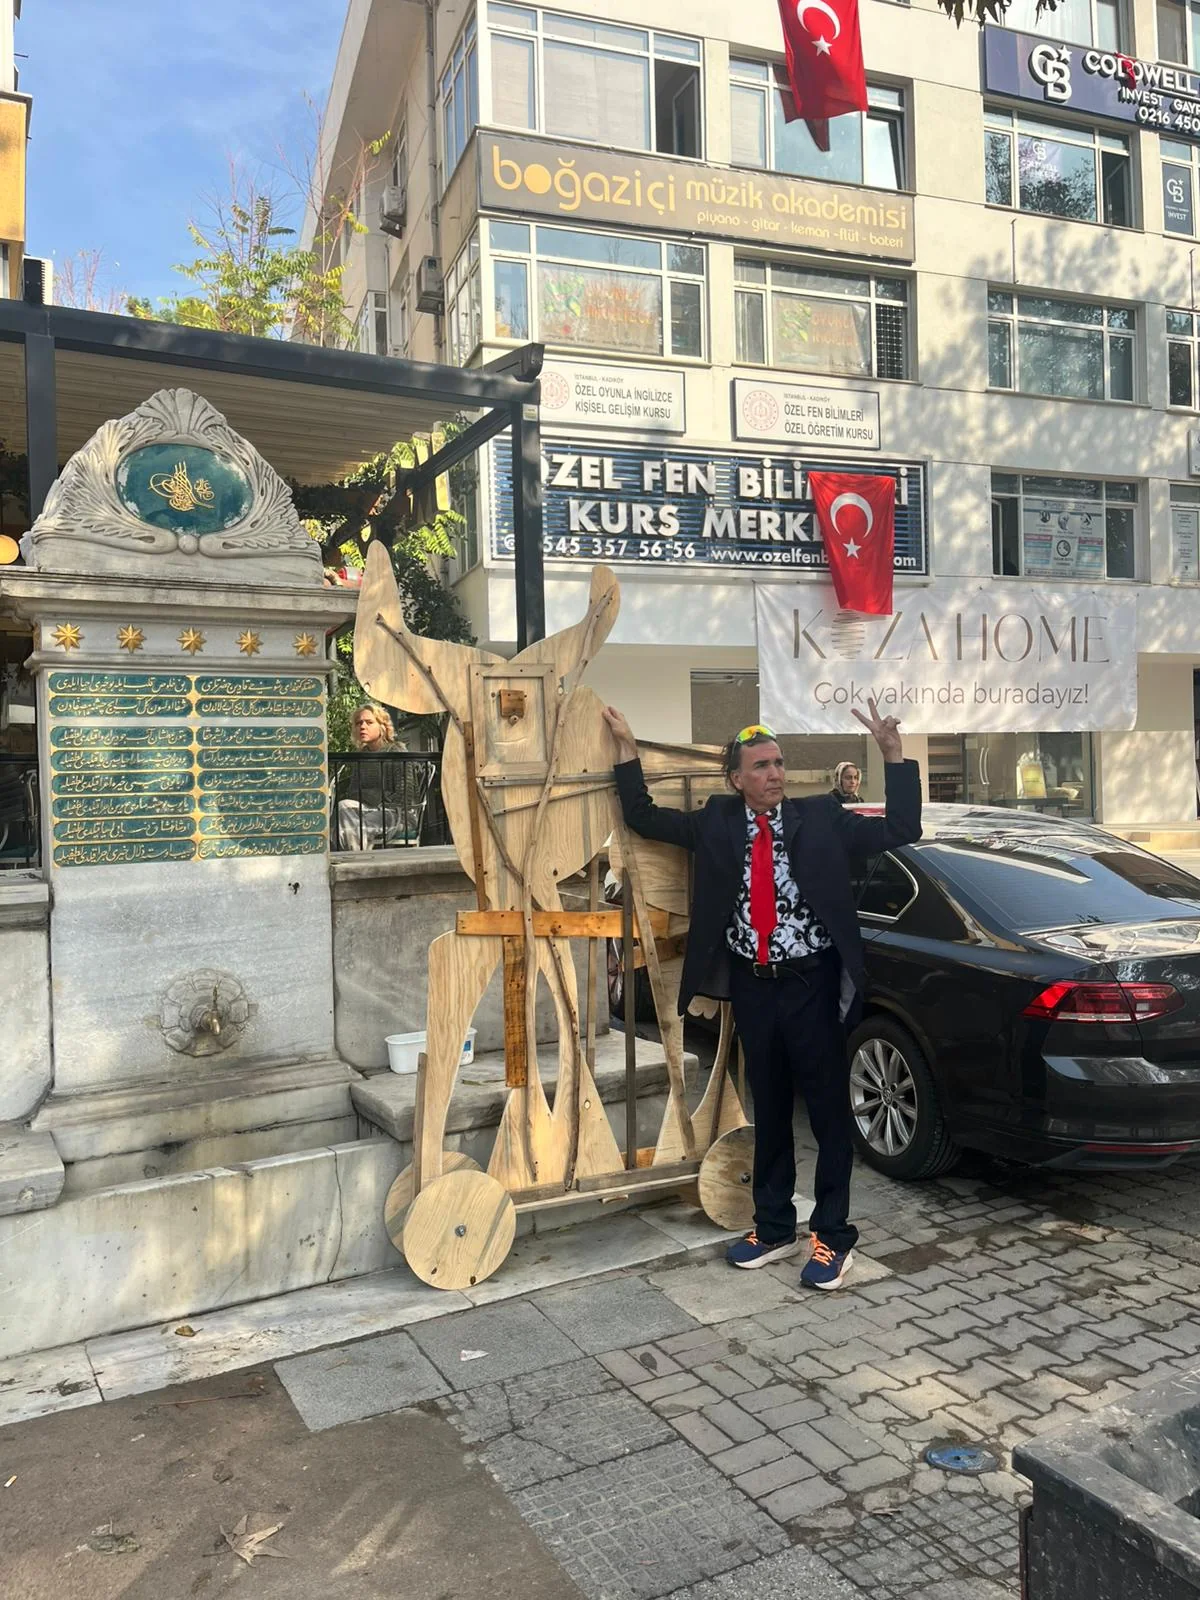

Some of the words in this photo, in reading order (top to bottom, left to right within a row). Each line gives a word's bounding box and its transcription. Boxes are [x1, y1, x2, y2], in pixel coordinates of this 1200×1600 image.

[1122, 87, 1165, 107] INVEST
[1139, 106, 1171, 125] 0216
[492, 144, 676, 216] boğaziçi
[686, 177, 763, 209] müzik
[772, 188, 907, 230] akademisi
[791, 221, 830, 239] keman
[870, 232, 904, 249] bateri
[574, 383, 599, 398] ÖZEL
[600, 386, 633, 400] OYUNLA
[634, 387, 673, 403] İNGİLİZCE
[575, 400, 607, 416] KİŞİSEL
[608, 403, 642, 418] GELİŞİM
[643, 407, 671, 419] KURSU
[784, 401, 806, 417] ÖZEL
[807, 406, 824, 418] FEN
[825, 407, 864, 422] BİLİMLERİ
[784, 419, 806, 435] ÖZEL
[807, 420, 845, 438] ÖĞRETİM
[846, 428, 874, 441] KURSU
[643, 460, 717, 495] FEN
[569, 499, 681, 537] KURS
[591, 538, 628, 556] 357
[957, 612, 1110, 662] HOME
[814, 681, 864, 710] Çok
[871, 681, 964, 706] yakında
[974, 681, 1088, 710] buradayız!
